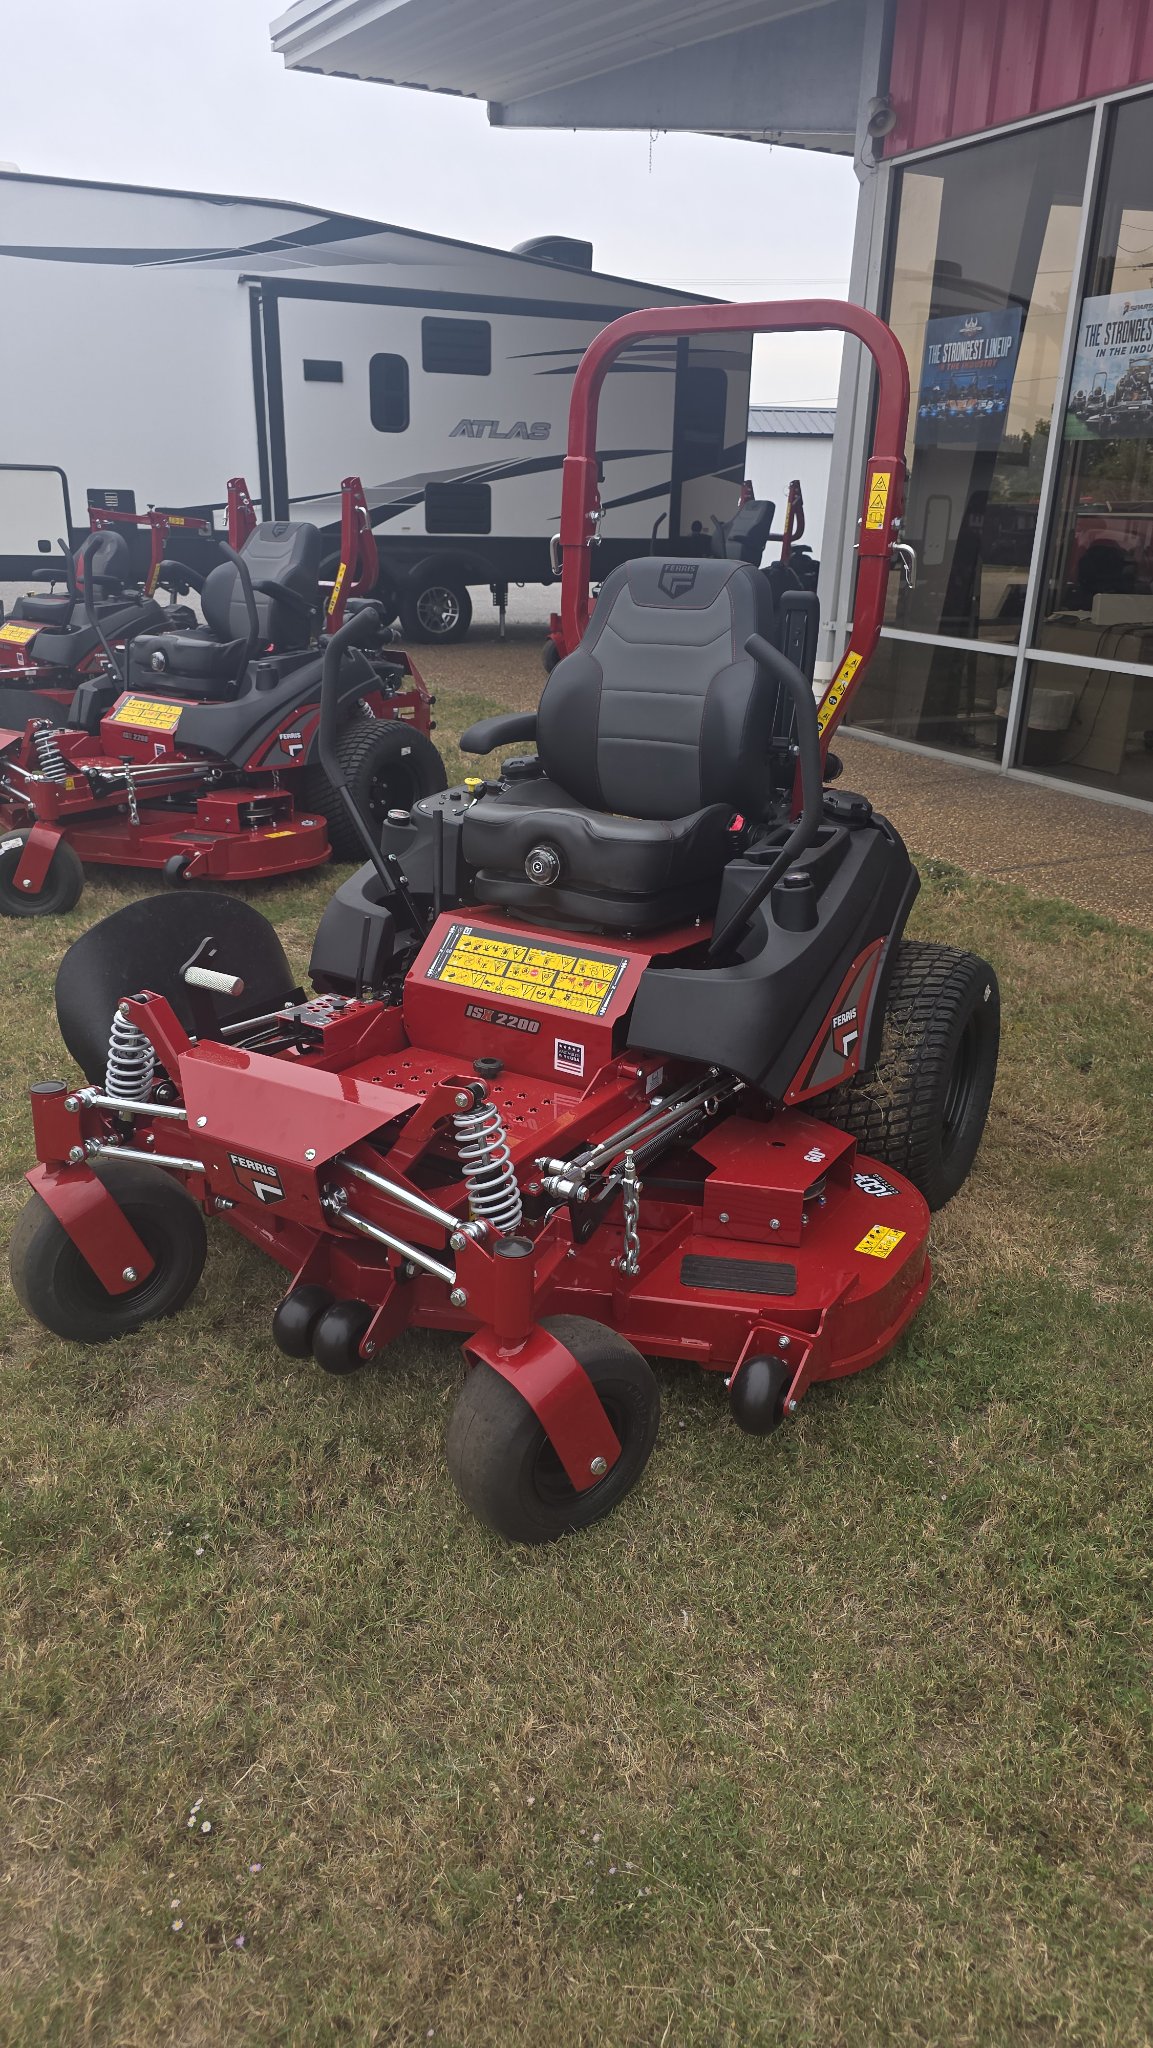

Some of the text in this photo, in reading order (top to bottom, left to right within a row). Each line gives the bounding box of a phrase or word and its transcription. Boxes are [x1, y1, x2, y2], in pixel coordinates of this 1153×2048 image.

[1085, 323, 1103, 347] THE
[928, 336, 1012, 364] THE STRONGEST LINEUP
[1096, 349, 1107, 358] IN
[1109, 346, 1127, 357] THE
[448, 418, 552, 441] ATLAS
[665, 564, 696, 573] FERRIS
[279, 732, 302, 740] FERRIS
[466, 1005, 540, 1033] ISX 2200
[832, 1007, 857, 1029] FERRIS
[230, 1154, 277, 1177] FERRIS
